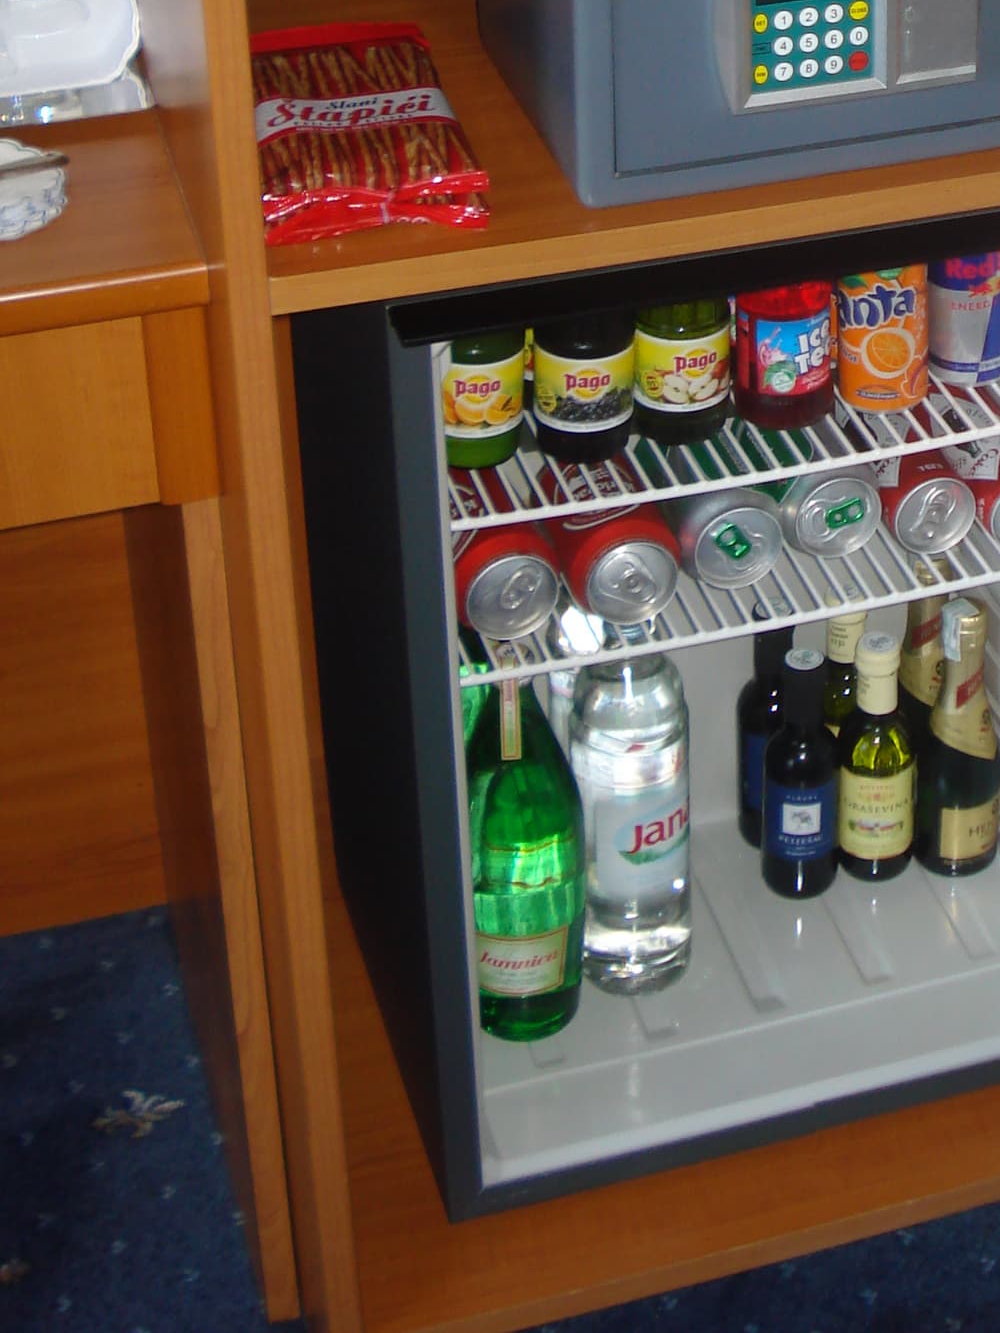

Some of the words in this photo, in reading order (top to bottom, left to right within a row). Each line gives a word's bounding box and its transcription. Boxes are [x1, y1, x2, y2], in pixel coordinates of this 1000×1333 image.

[805, 12, 813, 22] 2
[831, 9, 838, 19] 3
[780, 41, 787, 51] 4
[805, 38, 813, 48] 5
[830, 34, 838, 44] 6
[855, 31, 863, 41] 0
[780, 67, 787, 76] 7
[805, 63, 813, 73] 8
[830, 60, 838, 70] 9
